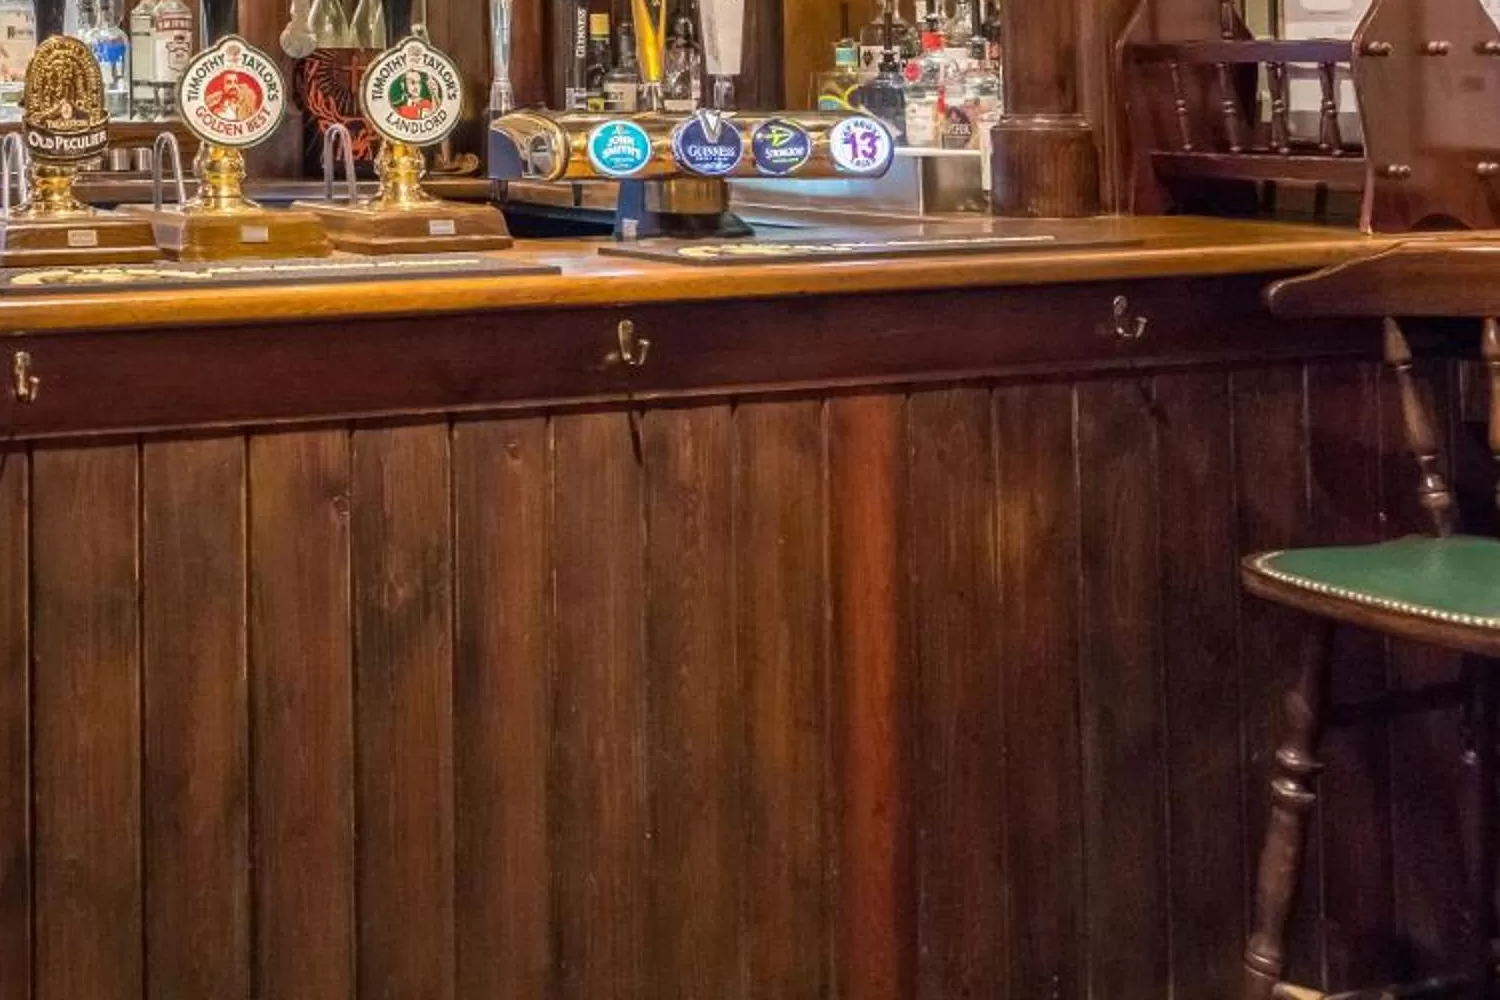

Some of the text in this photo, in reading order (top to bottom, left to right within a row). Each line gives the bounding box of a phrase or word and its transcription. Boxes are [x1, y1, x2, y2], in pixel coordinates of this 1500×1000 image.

[187, 53, 279, 102] TIMOTHY TAYLOR'S
[371, 53, 457, 101] TIMOTHY TAYLOR'S
[195, 105, 271, 136] GOLDEN BEST
[385, 109, 448, 134] LANDLORD
[28, 130, 107, 150] OLD PECULIER
[844, 131, 881, 159] 13
